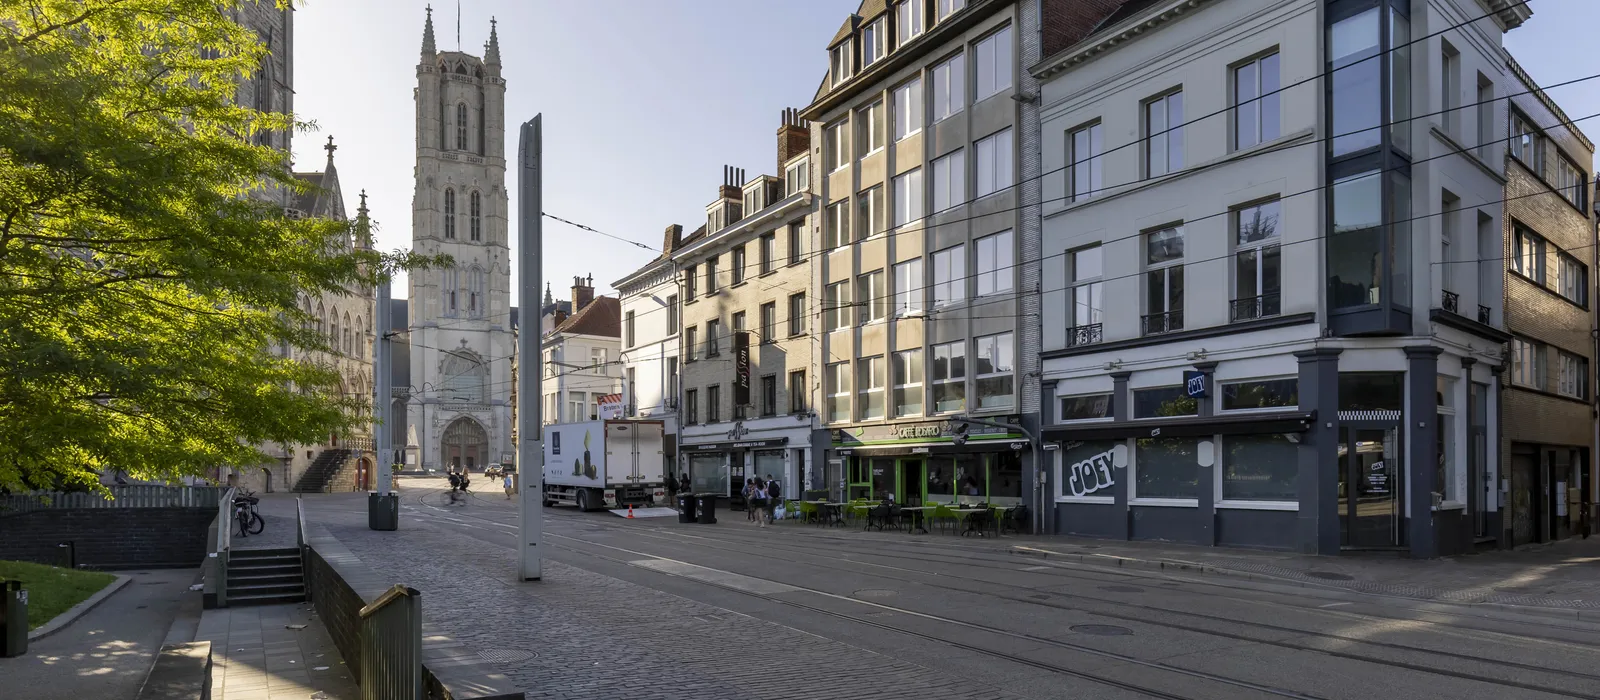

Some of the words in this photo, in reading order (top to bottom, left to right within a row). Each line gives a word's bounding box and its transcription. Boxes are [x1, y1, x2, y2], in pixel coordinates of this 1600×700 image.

[737, 350, 750, 389] passion
[1188, 375, 1204, 395] JOEY
[1069, 448, 1115, 497] JOEY
